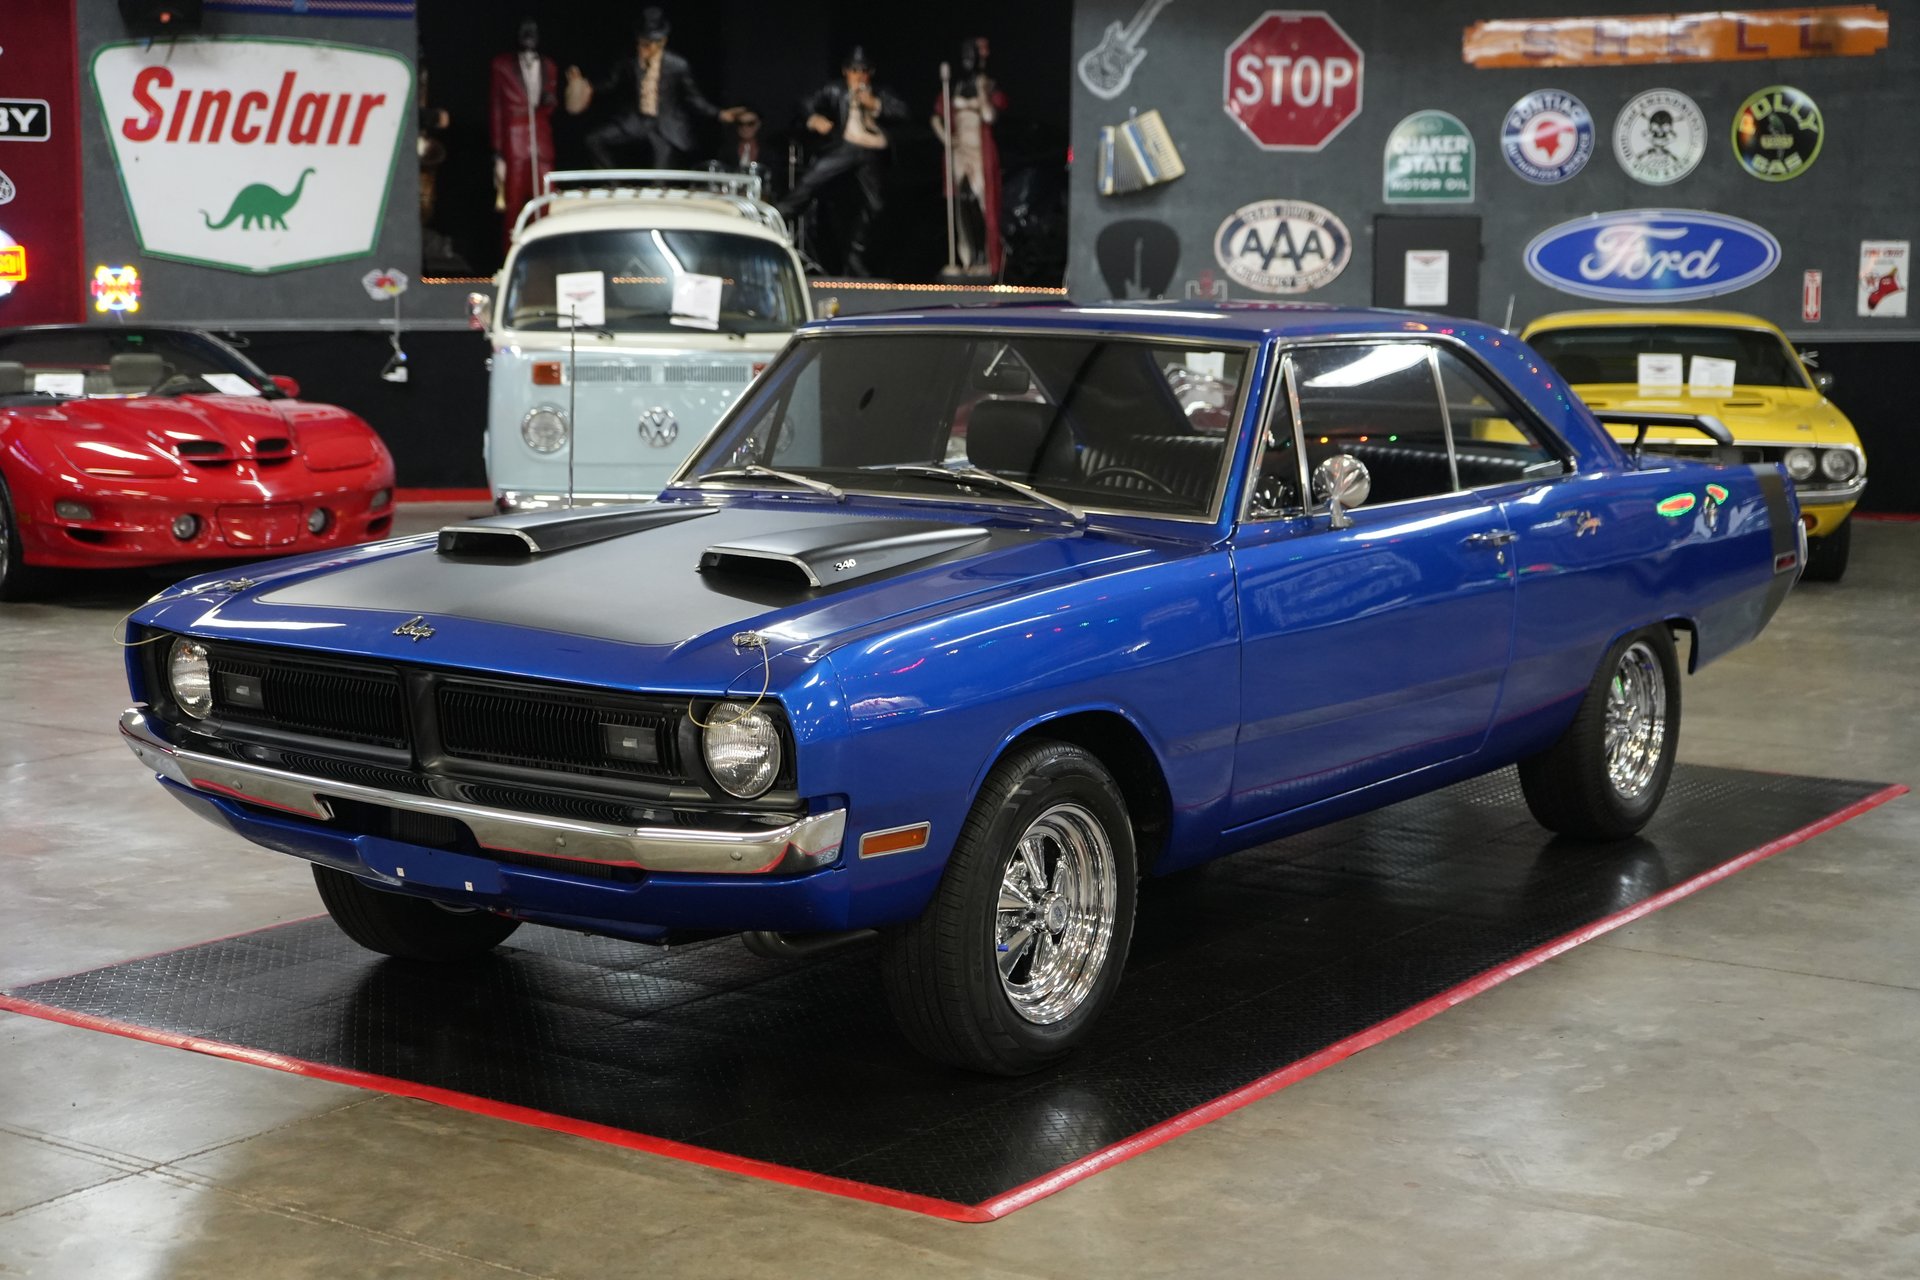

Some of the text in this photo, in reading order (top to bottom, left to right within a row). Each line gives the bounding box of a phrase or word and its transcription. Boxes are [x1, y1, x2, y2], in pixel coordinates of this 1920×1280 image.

[1521, 16, 1832, 59] SHELL
[1235, 55, 1353, 107] STOP
[122, 66, 386, 145] Sinclair
[1510, 94, 1588, 129] PONTIAC
[1391, 135, 1469, 154] QUAKER
[1398, 154, 1463, 174] STATE
[1752, 152, 1802, 175] GAS
[1391, 177, 1469, 191] MOTOR OIL
[1240, 220, 1325, 271] AAA
[1579, 225, 1724, 279] Ford
[836, 558, 857, 571] 340
